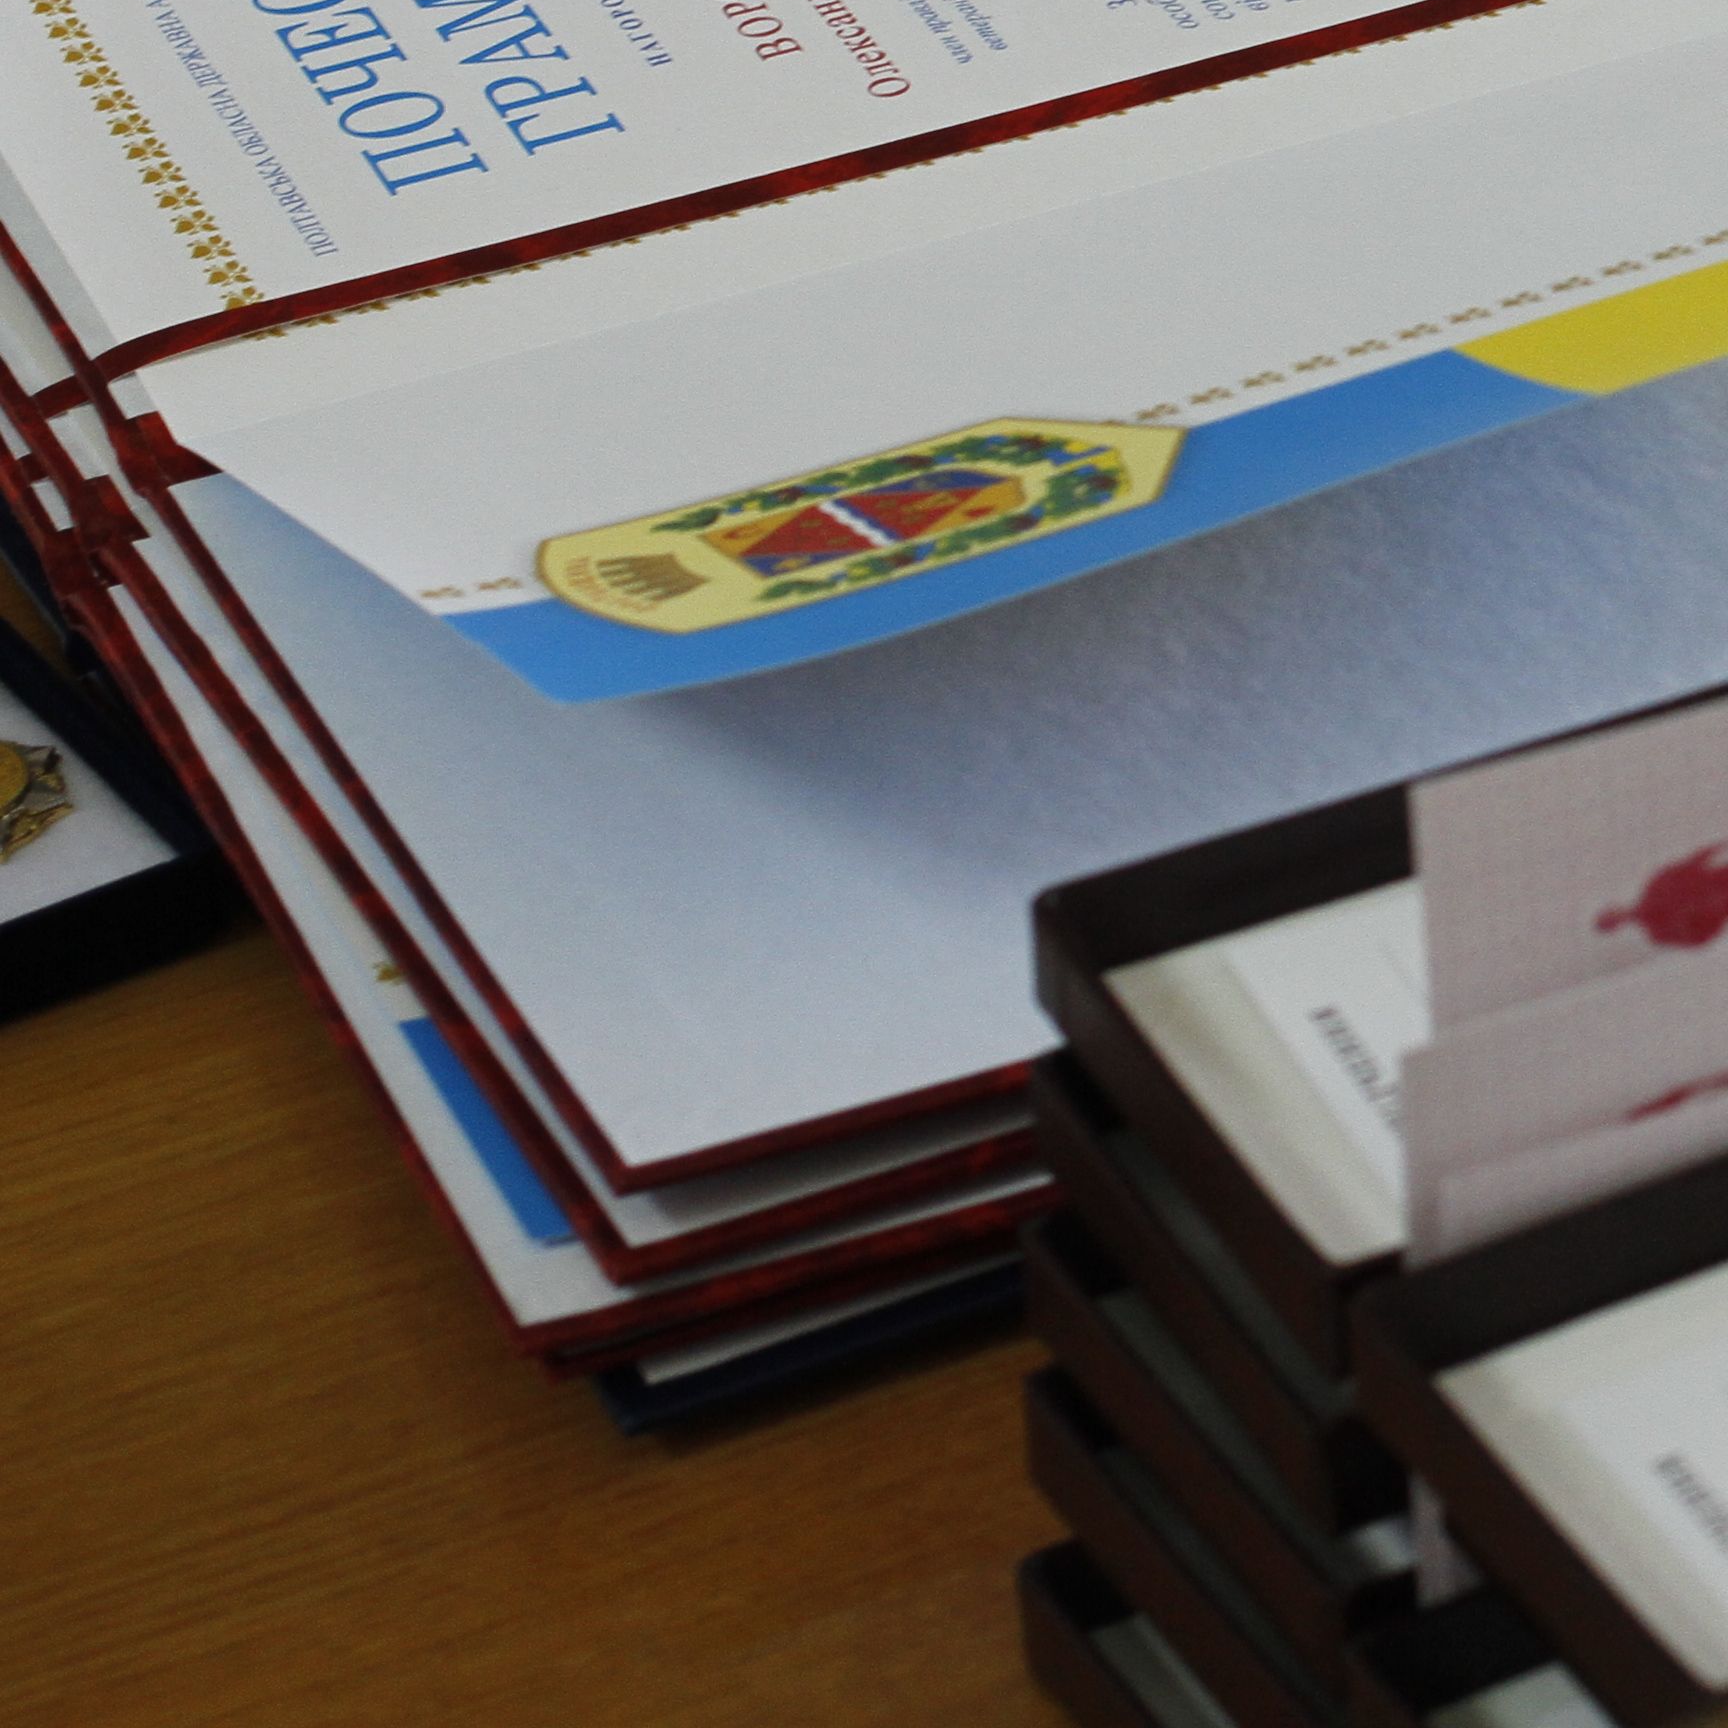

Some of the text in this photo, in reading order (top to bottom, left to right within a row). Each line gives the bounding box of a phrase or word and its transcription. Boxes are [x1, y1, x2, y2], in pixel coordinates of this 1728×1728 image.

[154, 9, 229, 88] ДЕРЖАВНА
[939, 35, 974, 65] член
[207, 87, 270, 157] ОБЛАСНА
[254, 155, 339, 258] ПОЛТАВСЬКА
